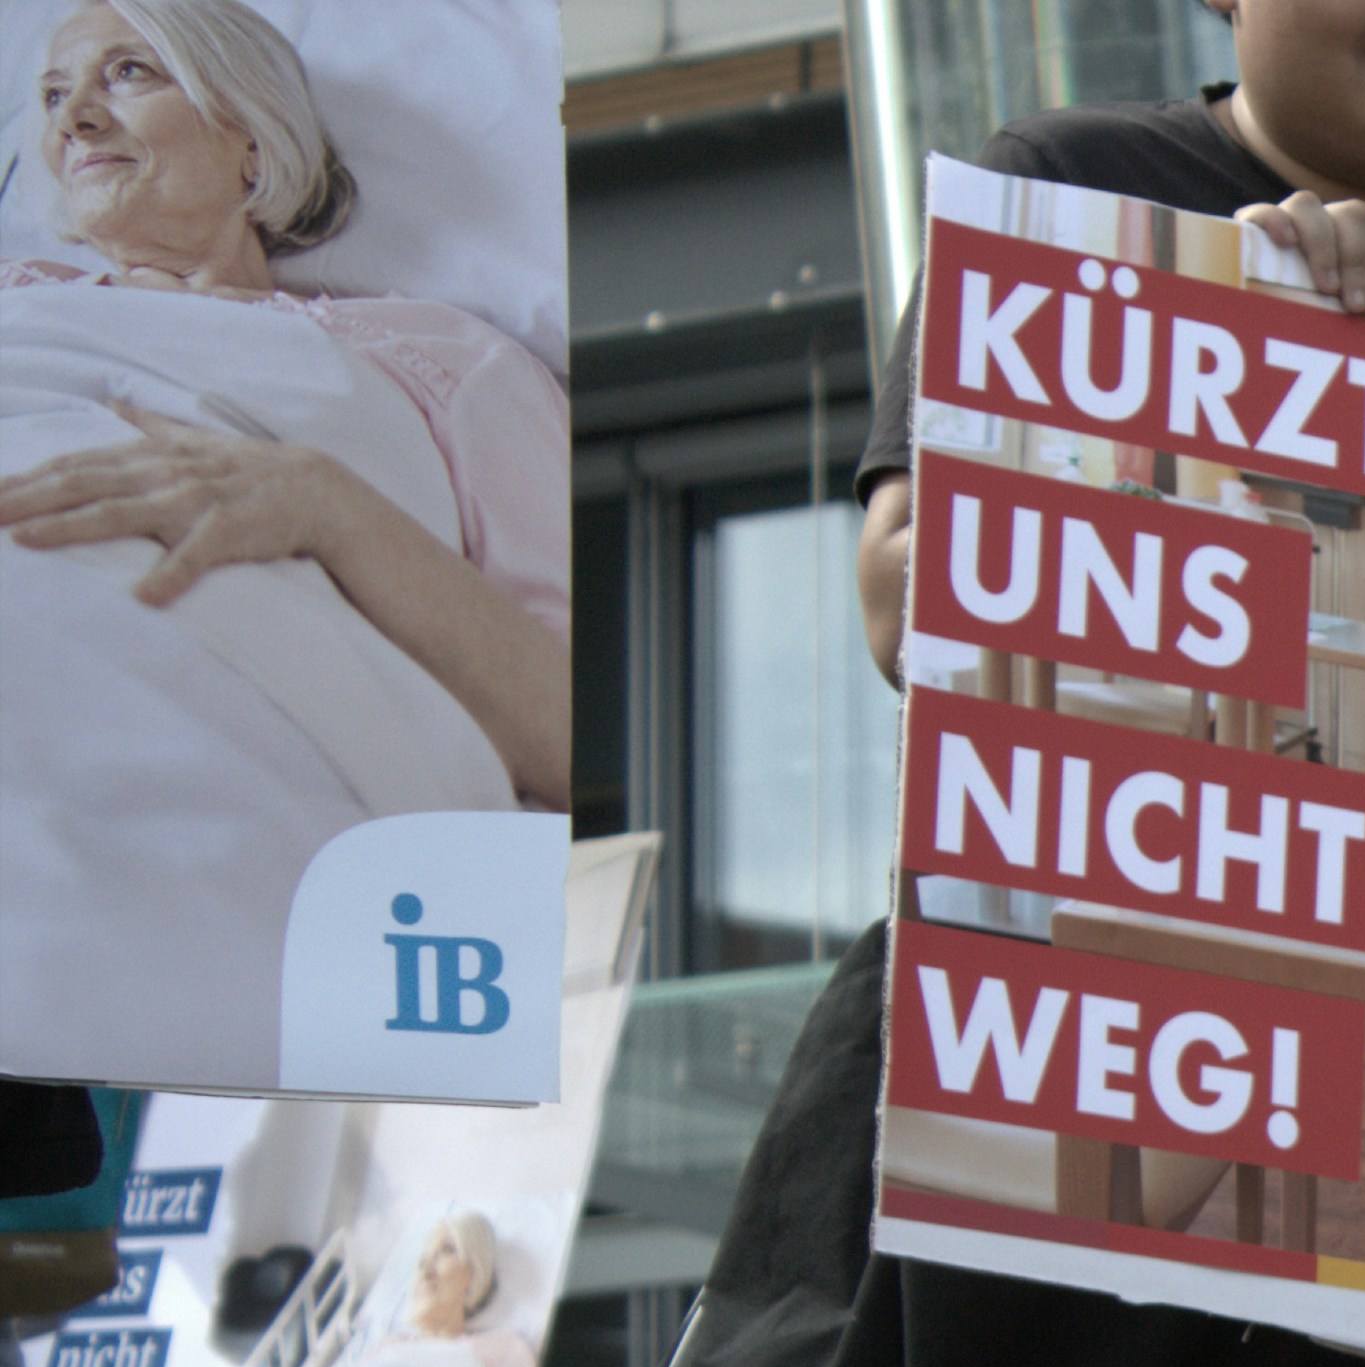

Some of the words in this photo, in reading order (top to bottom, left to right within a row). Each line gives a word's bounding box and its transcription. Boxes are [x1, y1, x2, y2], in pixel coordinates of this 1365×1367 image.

[949, 492, 1252, 668] UNS
[916, 964, 1301, 1150] WEG!
[124, 1175, 205, 1227] ürzt
